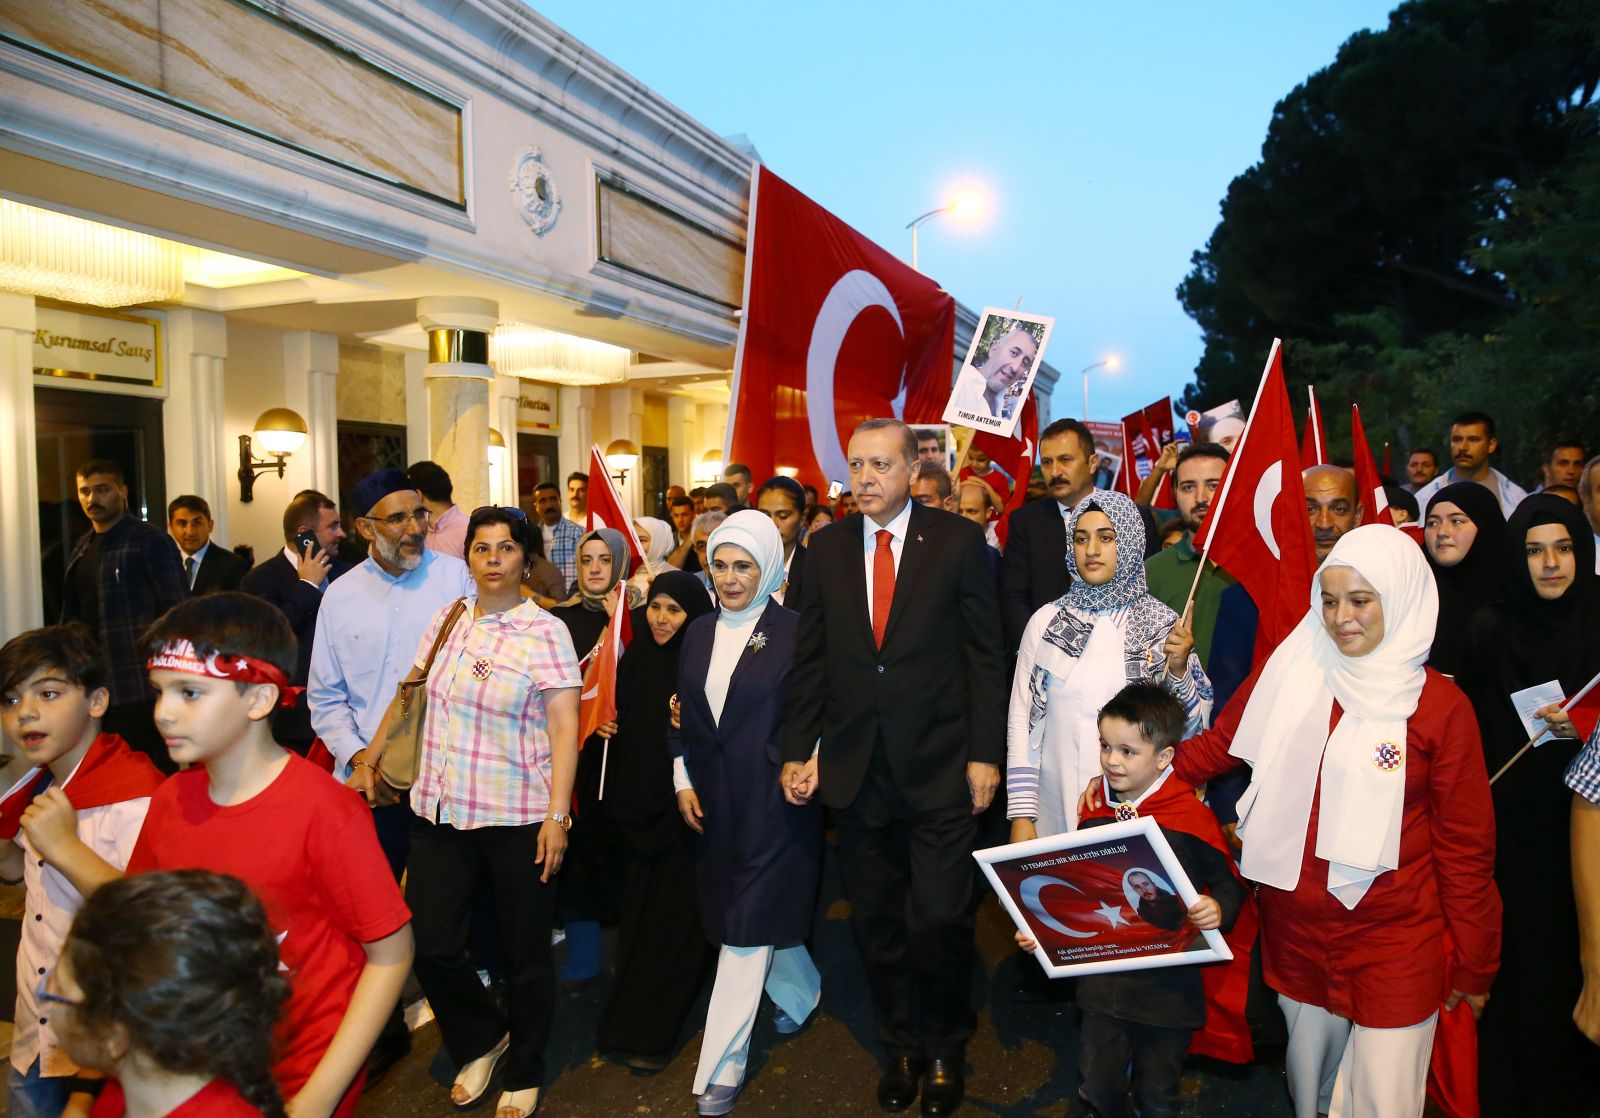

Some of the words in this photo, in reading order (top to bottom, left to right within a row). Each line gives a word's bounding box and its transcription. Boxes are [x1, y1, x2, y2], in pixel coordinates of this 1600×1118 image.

[33, 329, 116, 354] Kurumsal
[115, 340, 152, 362] Satış
[975, 416, 1001, 427] AKTEMUR
[1029, 860, 1056, 870] TEMMUZ
[1056, 856, 1069, 865] BİR
[1068, 850, 1100, 862] MİLLETİN
